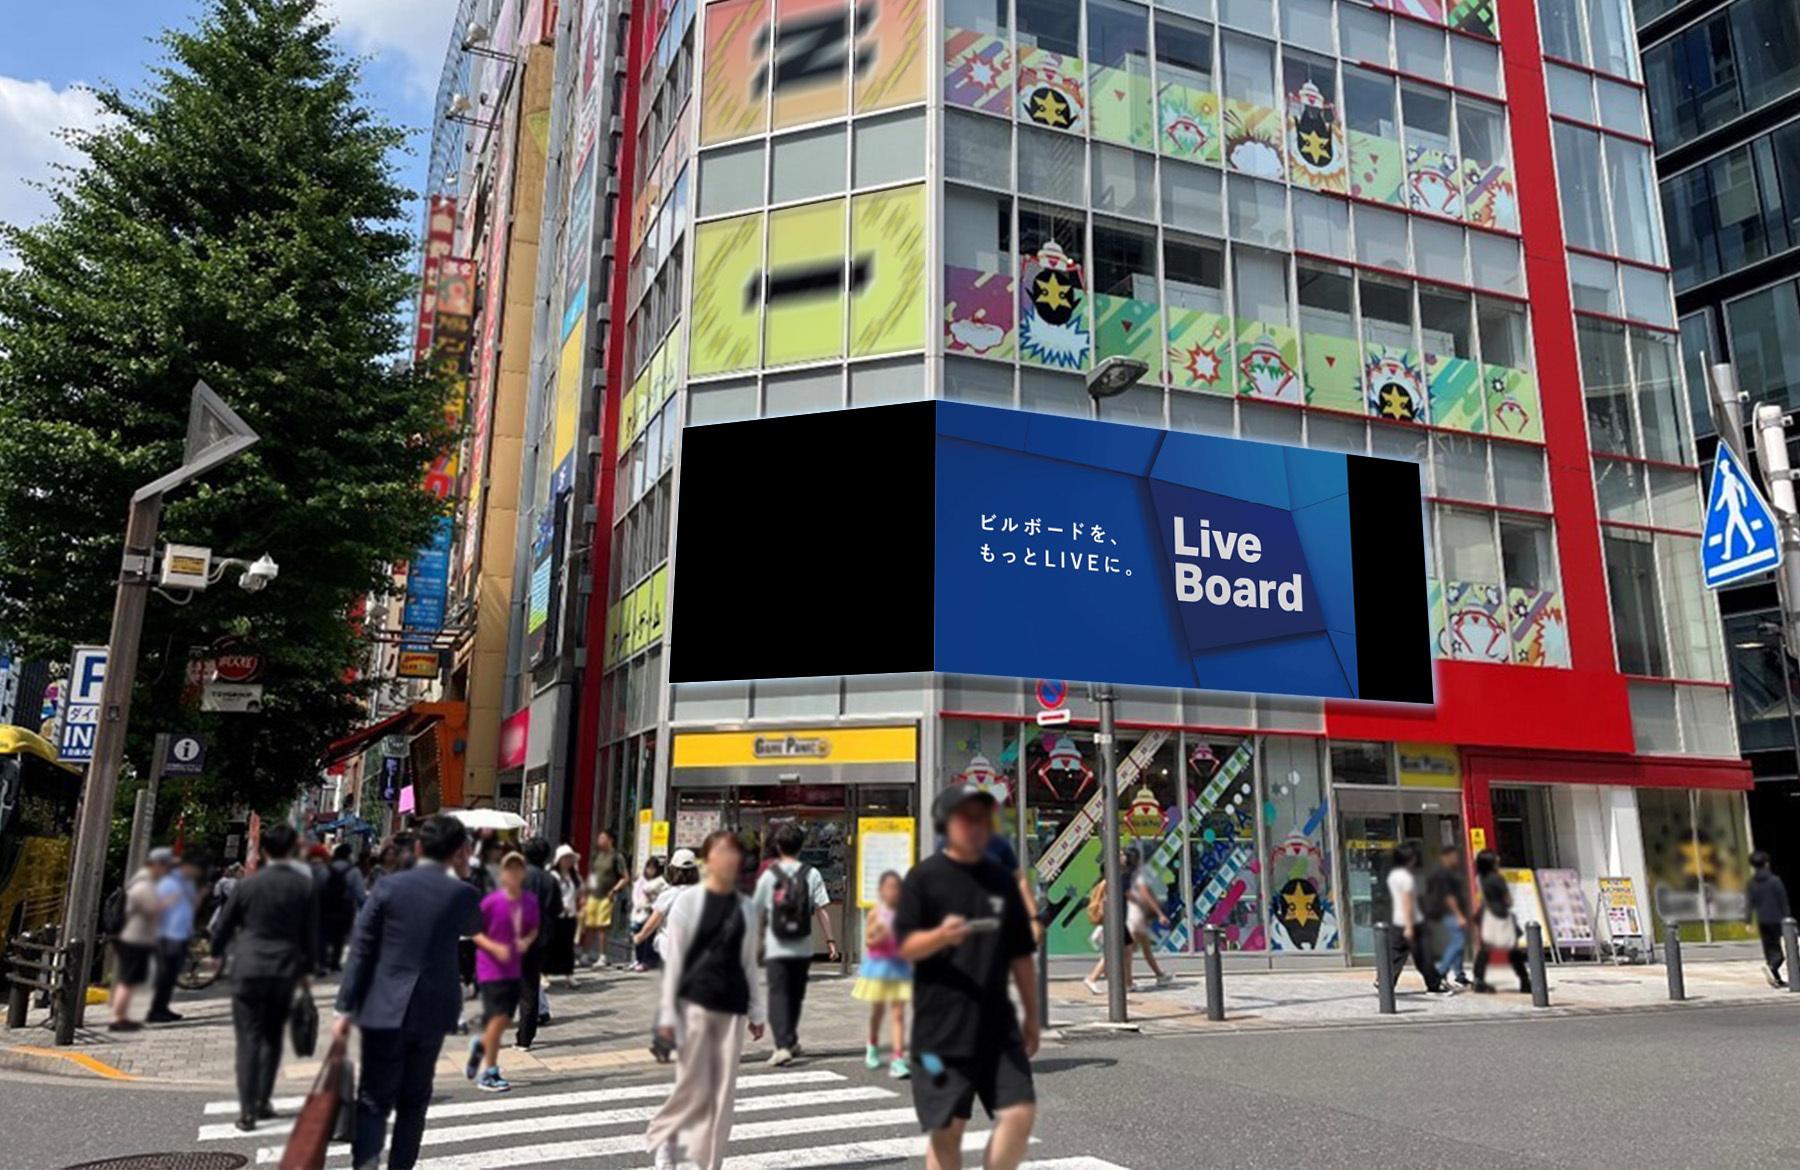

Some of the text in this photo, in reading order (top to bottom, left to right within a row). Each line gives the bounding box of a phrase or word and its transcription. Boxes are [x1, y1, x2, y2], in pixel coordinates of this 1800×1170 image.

[981, 514, 1117, 546] ビルボードを、
[1174, 516, 1262, 563] Live
[980, 543, 1132, 577] もっとLIVEに。
[1175, 562, 1303, 612] Board
